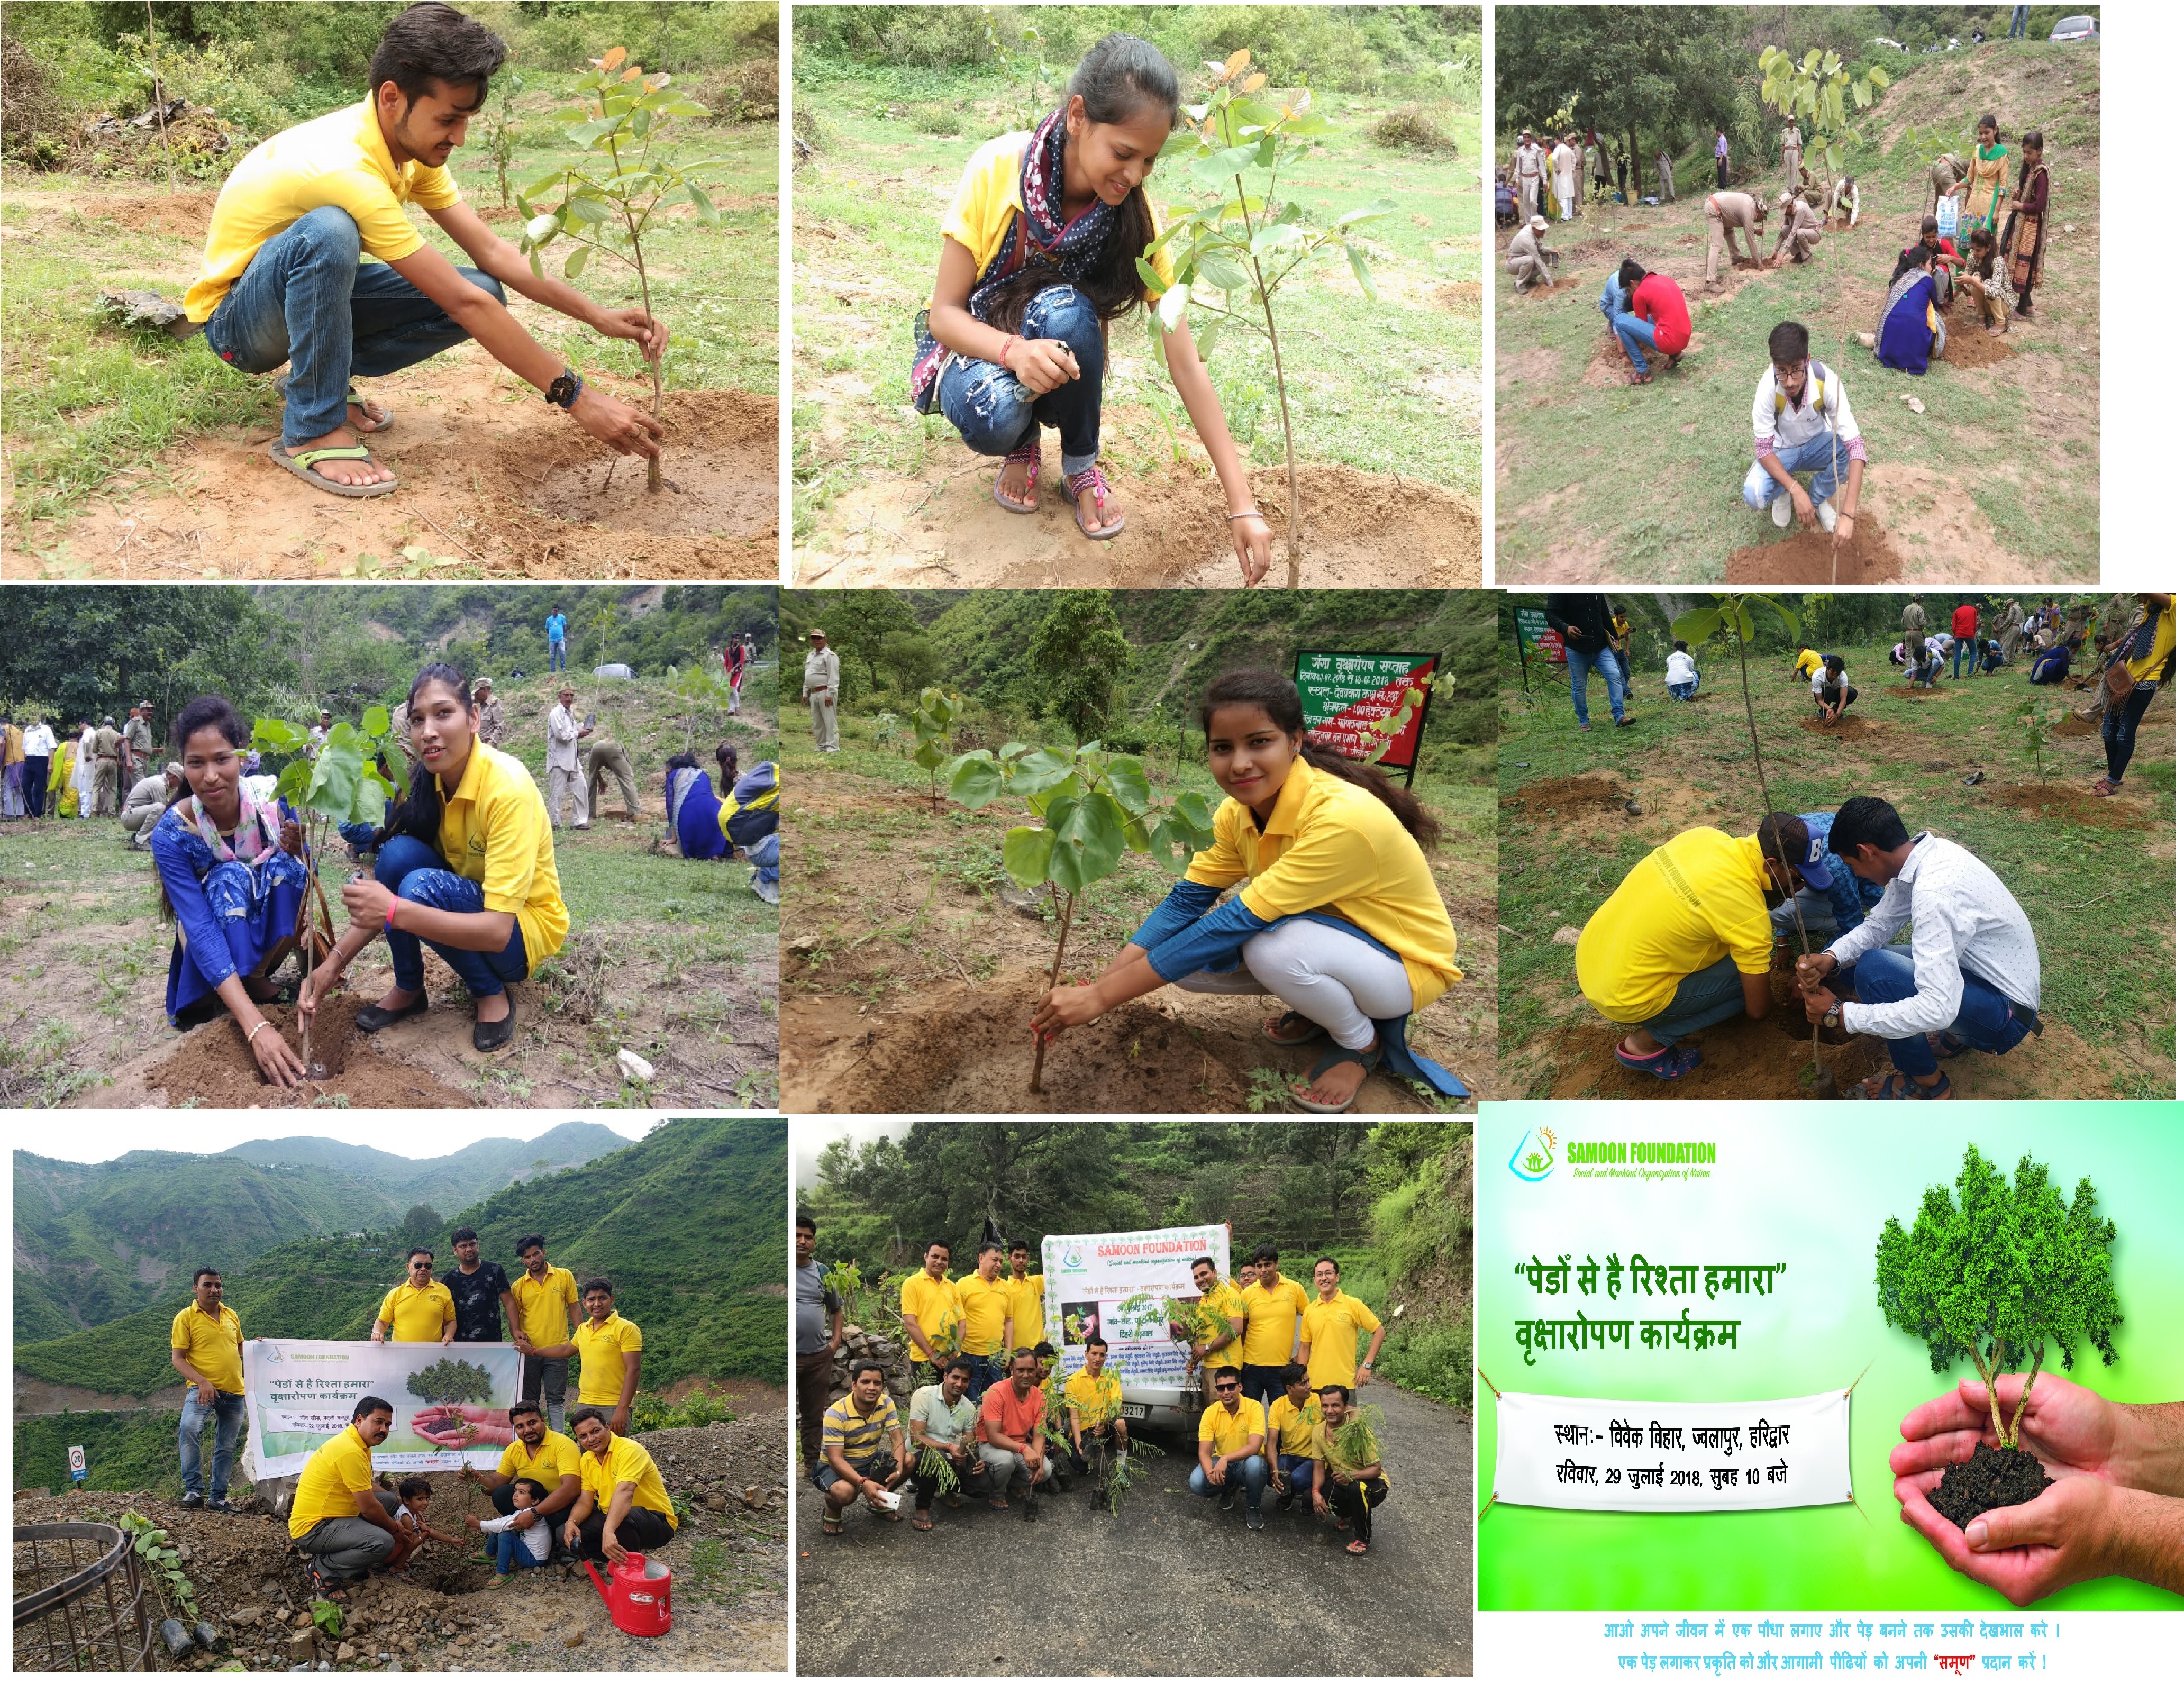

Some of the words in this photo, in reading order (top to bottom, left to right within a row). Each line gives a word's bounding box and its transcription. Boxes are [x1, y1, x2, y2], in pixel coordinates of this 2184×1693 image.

[1311, 654, 1331, 669] गंगा
[1336, 655, 1375, 674] वृक्षारोपण
[1379, 661, 1411, 676] सप्ताह
[1347, 672, 1354, 684] से
[1396, 676, 1414, 687] तक
[1334, 685, 1361, 699] देवप्रयाग
[1313, 716, 1321, 725] का
[1809, 838, 1822, 862] B
[1668, 866, 1701, 908] FOUNDATION
[1568, 1142, 1626, 1163] SAMOON
[1631, 1142, 1715, 1163] FOUNDATION
[1573, 1167, 1594, 1178] Social
[1595, 1167, 1607, 1178] and
[1608, 1167, 1637, 1178] Mankind
[1639, 1167, 1680, 1181] Organization
[1681, 1167, 1689, 1181] of
[1690, 1167, 1710, 1178] Nation
[1098, 1243, 1140, 1257] SAMOON
[1142, 1239, 1207, 1255] FOUNDATION
[1577, 1254, 1600, 1296] से
[1606, 1252, 1624, 1300] है
[1630, 1254, 1699, 1296] रिश्ता
[1704, 1263, 1787, 1300] हमारा”
[1119, 1330, 1133, 1339] टिहरी
[1515, 1309, 1634, 1366] वृक्षारोपण
[1640, 1308, 1741, 1351] कार्यक्रम
[295, 1379, 304, 1388] से
[306, 1378, 313, 1389] है
[315, 1378, 341, 1389] रिश्ता
[343, 1380, 375, 1389] हमारा”
[270, 1391, 317, 1403] वृक्षारोपण
[319, 1390, 358, 1400] कार्यक्रम
[316, 1422, 329, 1431] जुलाई
[1609, 1418, 1643, 1448] विवेक
[1649, 1421, 1685, 1451] विहार,
[1692, 1427, 1742, 1457] ज्वलापुर,
[1749, 1418, 1790, 1448] हरिद्वार
[1556, 1459, 1598, 1486] रविवार,
[1605, 1468, 1621, 1483] 29
[1627, 1462, 1664, 1489] जुलाई
[1670, 1471, 1703, 1487] 2018,
[1709, 1469, 1739, 1490] सुबह
[1746, 1468, 1759, 1484] 10
[1767, 1458, 1788, 1484] बजे
[1604, 1619, 1634, 1637] आओ
[1640, 1619, 1669, 1637] अपने
[1676, 1619, 1708, 1637] जीवन
[1715, 1618, 1725, 1637] में
[1732, 1624, 1752, 1637] एक
[1758, 1619, 1784, 1637] पौधा
[1790, 1624, 1823, 1637] लगाए
[1829, 1618, 1851, 1637] और
[1857, 1619, 1873, 1641] पेड़
[1880, 1619, 1907, 1637] बनने
[1914, 1624, 1934, 1637] तक
[1941, 1619, 1974, 1637] उसकी
[1980, 1619, 2024, 1639] देखभाल
[2031, 1619, 2048, 1637] करे
[1618, 1656, 1638, 1669] एक
[1641, 1652, 1657, 1672] पेड़
[1660, 1656, 1701, 1670] लगाकर
[1703, 1651, 1736, 1676] प्रकृति
[1740, 1652, 1754, 1669] को
[1757, 1651, 1778, 1670] और
[1781, 1651, 1823, 1669] आगामी
[1830, 1651, 1867, 1669] पीढियों
[1874, 1652, 1888, 1669] को
[1895, 1651, 1927, 1669] अपनी
[1934, 1654, 1975, 1676] “समूण”
[1982, 1656, 2012, 1671] प्रदान
[2018, 1651, 2036, 1670] करें
